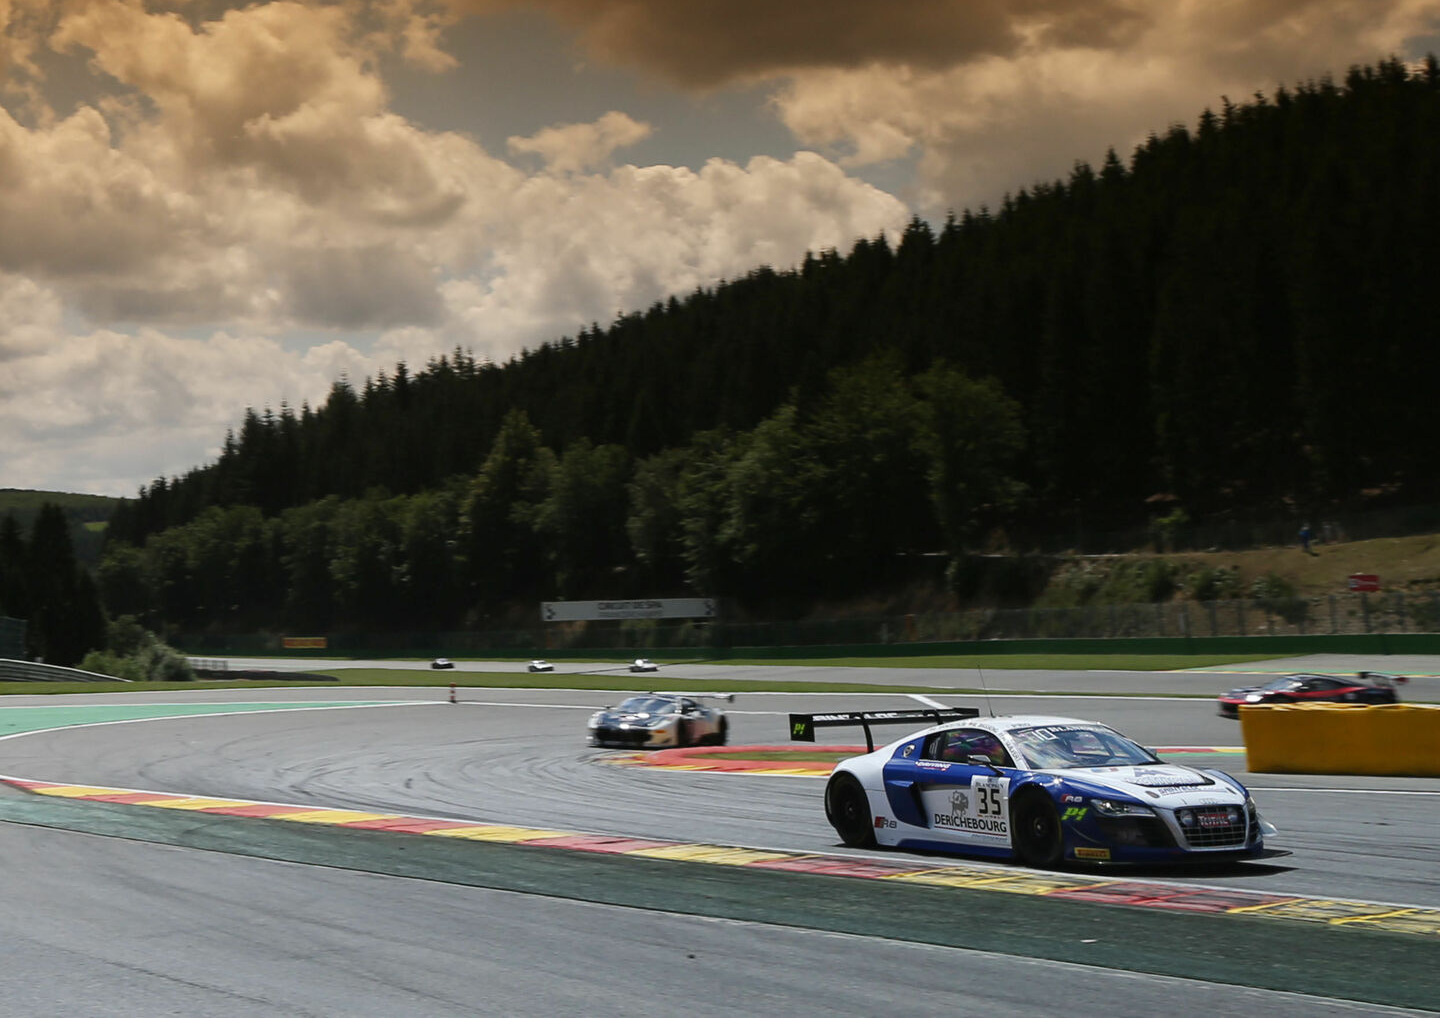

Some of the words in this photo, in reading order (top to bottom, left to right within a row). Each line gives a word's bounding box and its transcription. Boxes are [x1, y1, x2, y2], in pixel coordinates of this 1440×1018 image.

[977, 787, 1002, 816] 35
[883, 819, 897, 829] R8
[934, 813, 1008, 833] DERICHEBOURG
